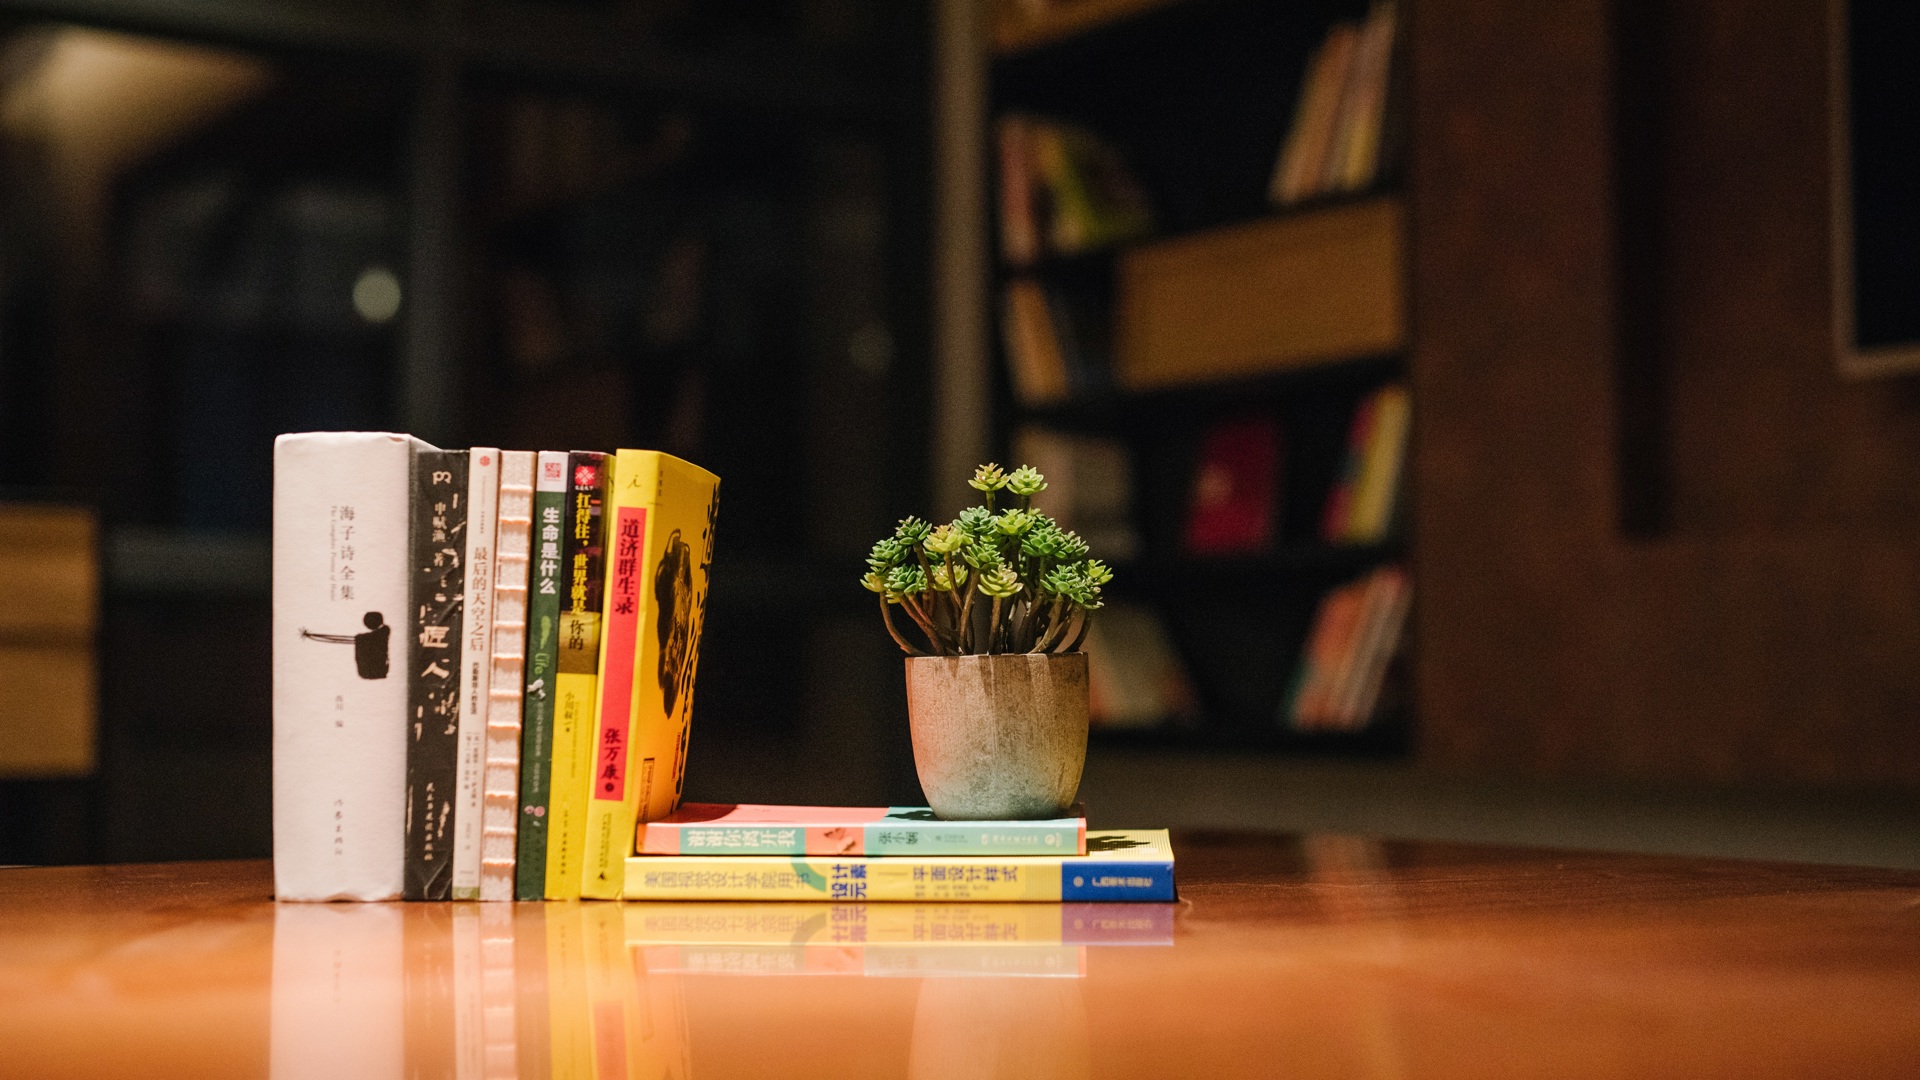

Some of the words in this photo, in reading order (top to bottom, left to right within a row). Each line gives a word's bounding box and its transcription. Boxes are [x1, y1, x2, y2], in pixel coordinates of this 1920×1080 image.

[340, 505, 356, 601] 海子诗全集
[539, 506, 561, 595] 生命是什么
[615, 518, 642, 615] 道济群生录
[469, 546, 488, 652] 最后的天空之后
[601, 728, 622, 780] 张万康
[687, 829, 797, 848] 谢谢你离开我
[644, 870, 812, 890] 美国视觉设计学院用书
[831, 864, 848, 899] 设计
[850, 864, 867, 899] 元素
[913, 865, 1019, 883] 平面设计样式
